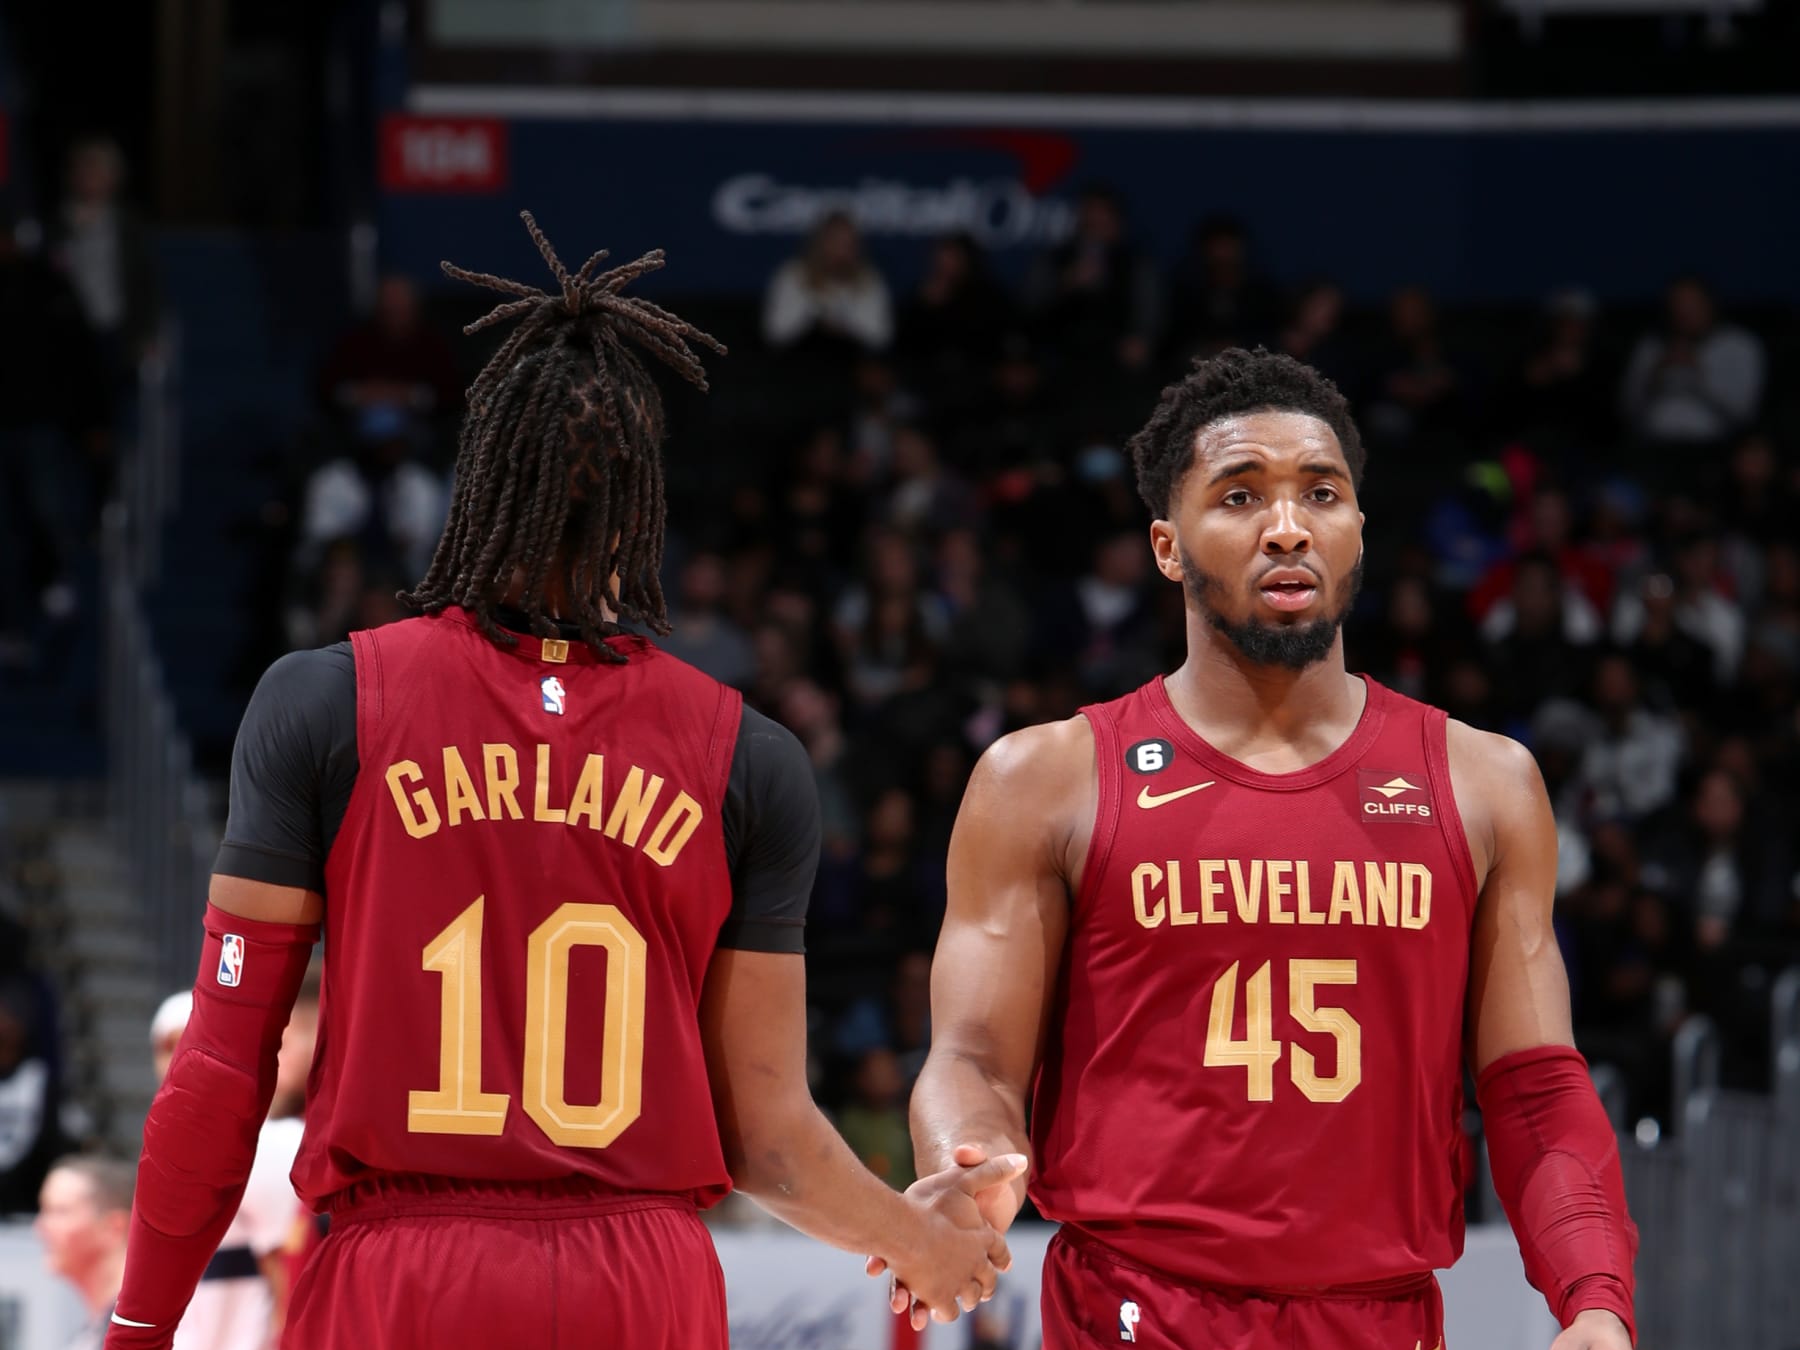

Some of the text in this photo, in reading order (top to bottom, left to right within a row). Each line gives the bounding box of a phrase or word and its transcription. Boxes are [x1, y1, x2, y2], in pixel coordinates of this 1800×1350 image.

[385, 743, 703, 866] GARLAND
[1137, 743, 1163, 771] 6
[1364, 802, 1431, 817] CLIFFS
[1131, 859, 1432, 930] CLEVELAND
[408, 894, 647, 1149] 10
[1203, 958, 1361, 1102] 45
